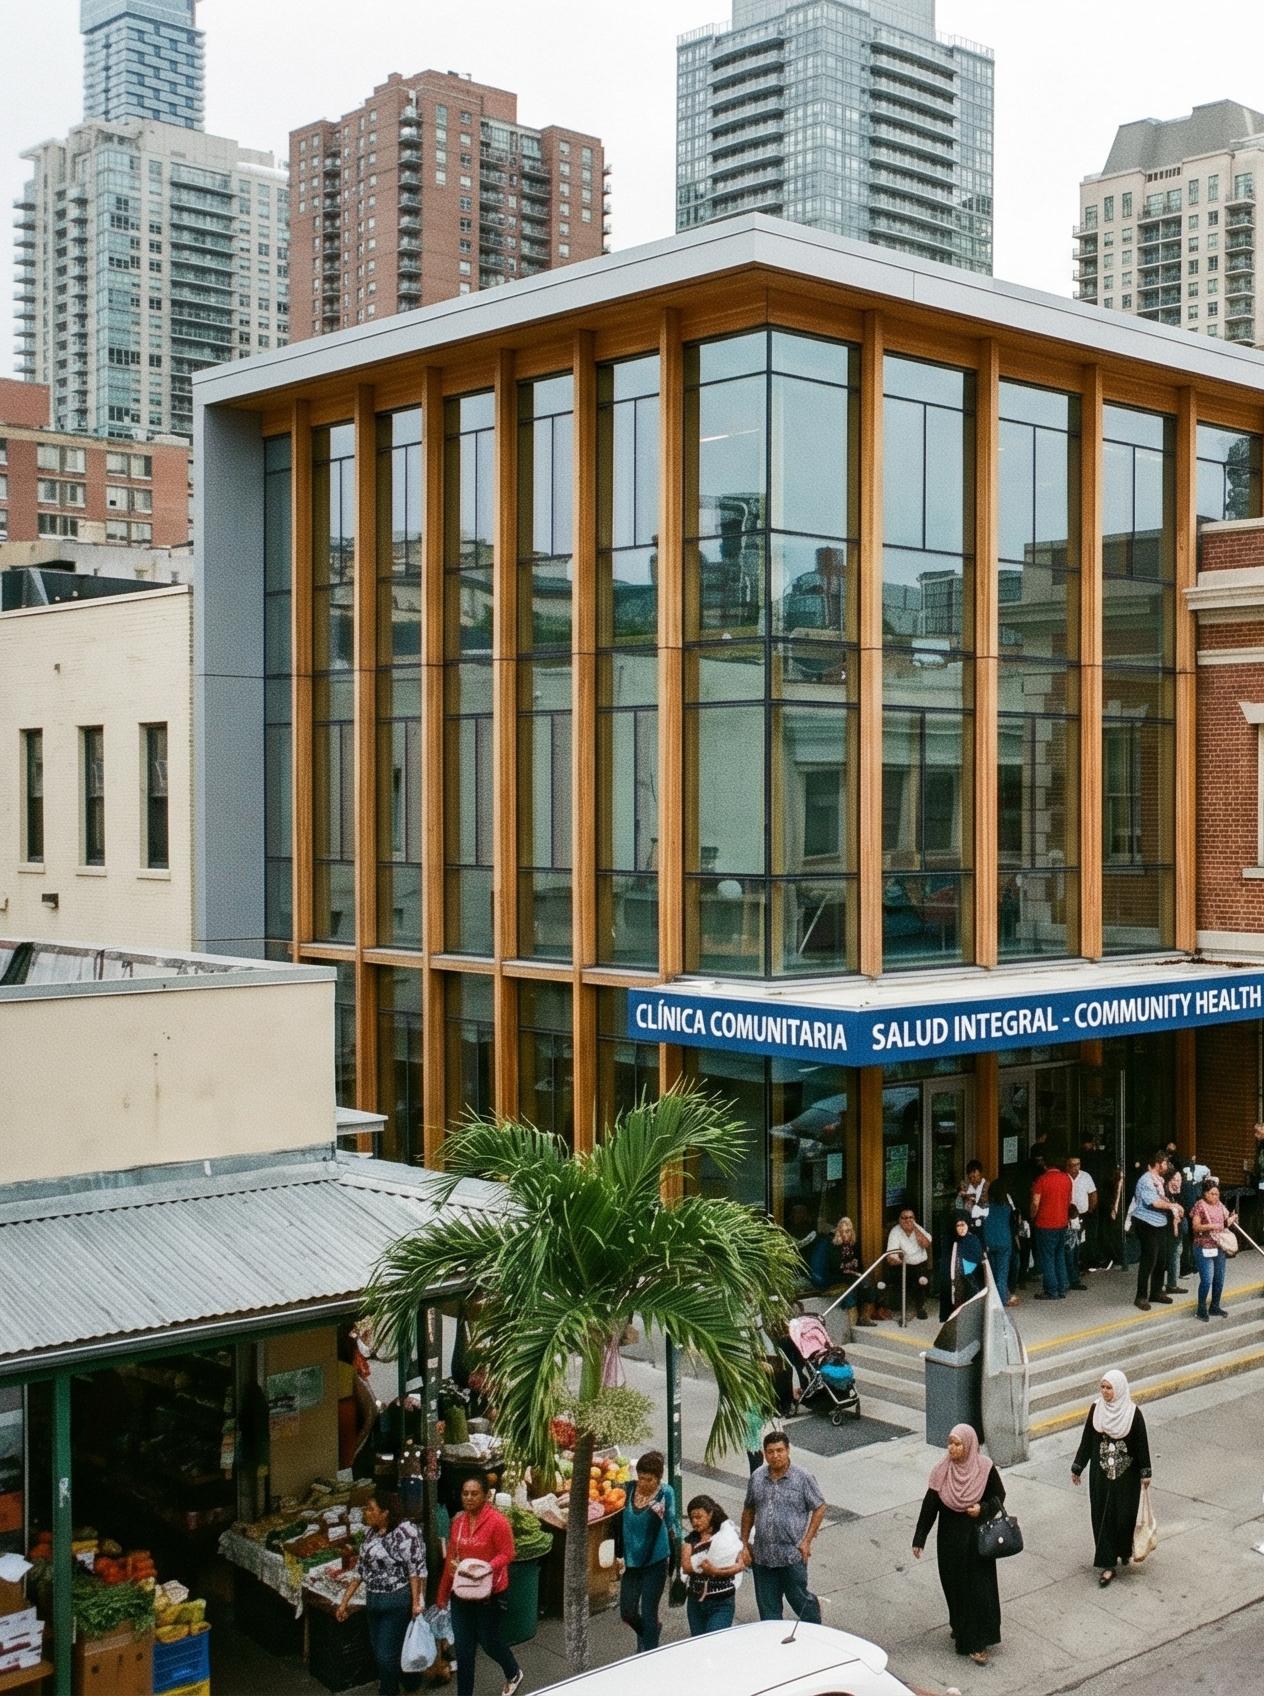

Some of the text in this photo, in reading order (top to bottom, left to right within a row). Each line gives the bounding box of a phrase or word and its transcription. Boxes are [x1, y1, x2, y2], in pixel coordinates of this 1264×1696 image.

[636, 999, 847, 1051] CLÍNICA COMUNITARIA
[872, 1017, 948, 1050] SALUD
[954, 1006, 1058, 1042] INTEGRAL
[1074, 992, 1192, 1028] COMMUNITY
[1196, 985, 1262, 1015] HEALTH
